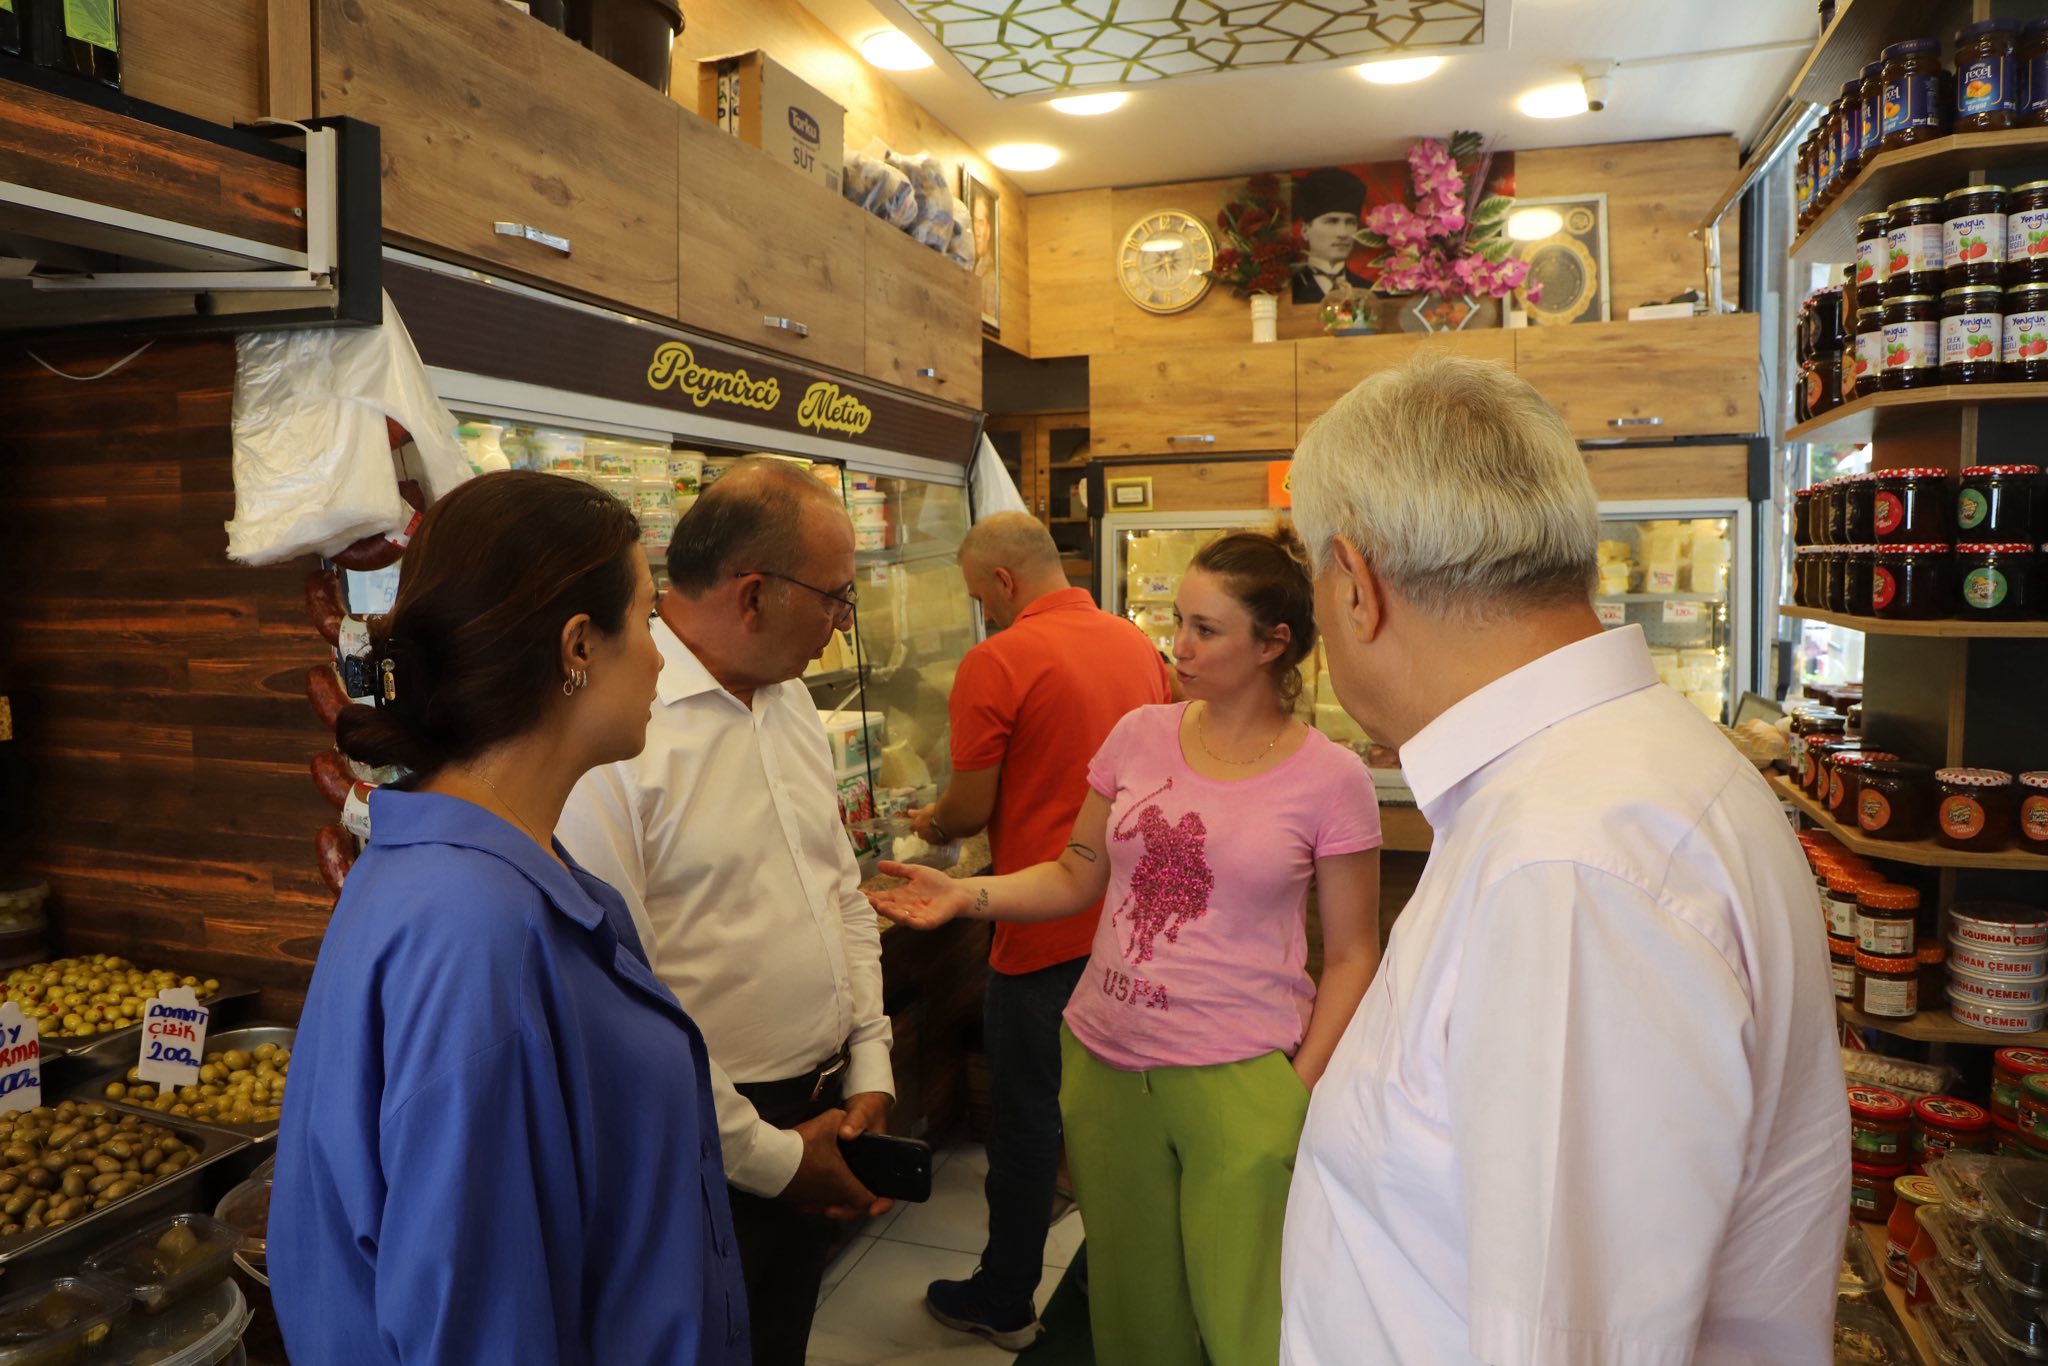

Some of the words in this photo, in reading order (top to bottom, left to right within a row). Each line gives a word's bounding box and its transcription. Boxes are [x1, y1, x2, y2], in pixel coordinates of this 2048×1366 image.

[791, 109, 817, 139] Torku
[793, 146, 815, 173] SÜT
[650, 346, 779, 406] Peynirci
[800, 387, 870, 429] Metin
[1103, 967, 1168, 1012] USPA
